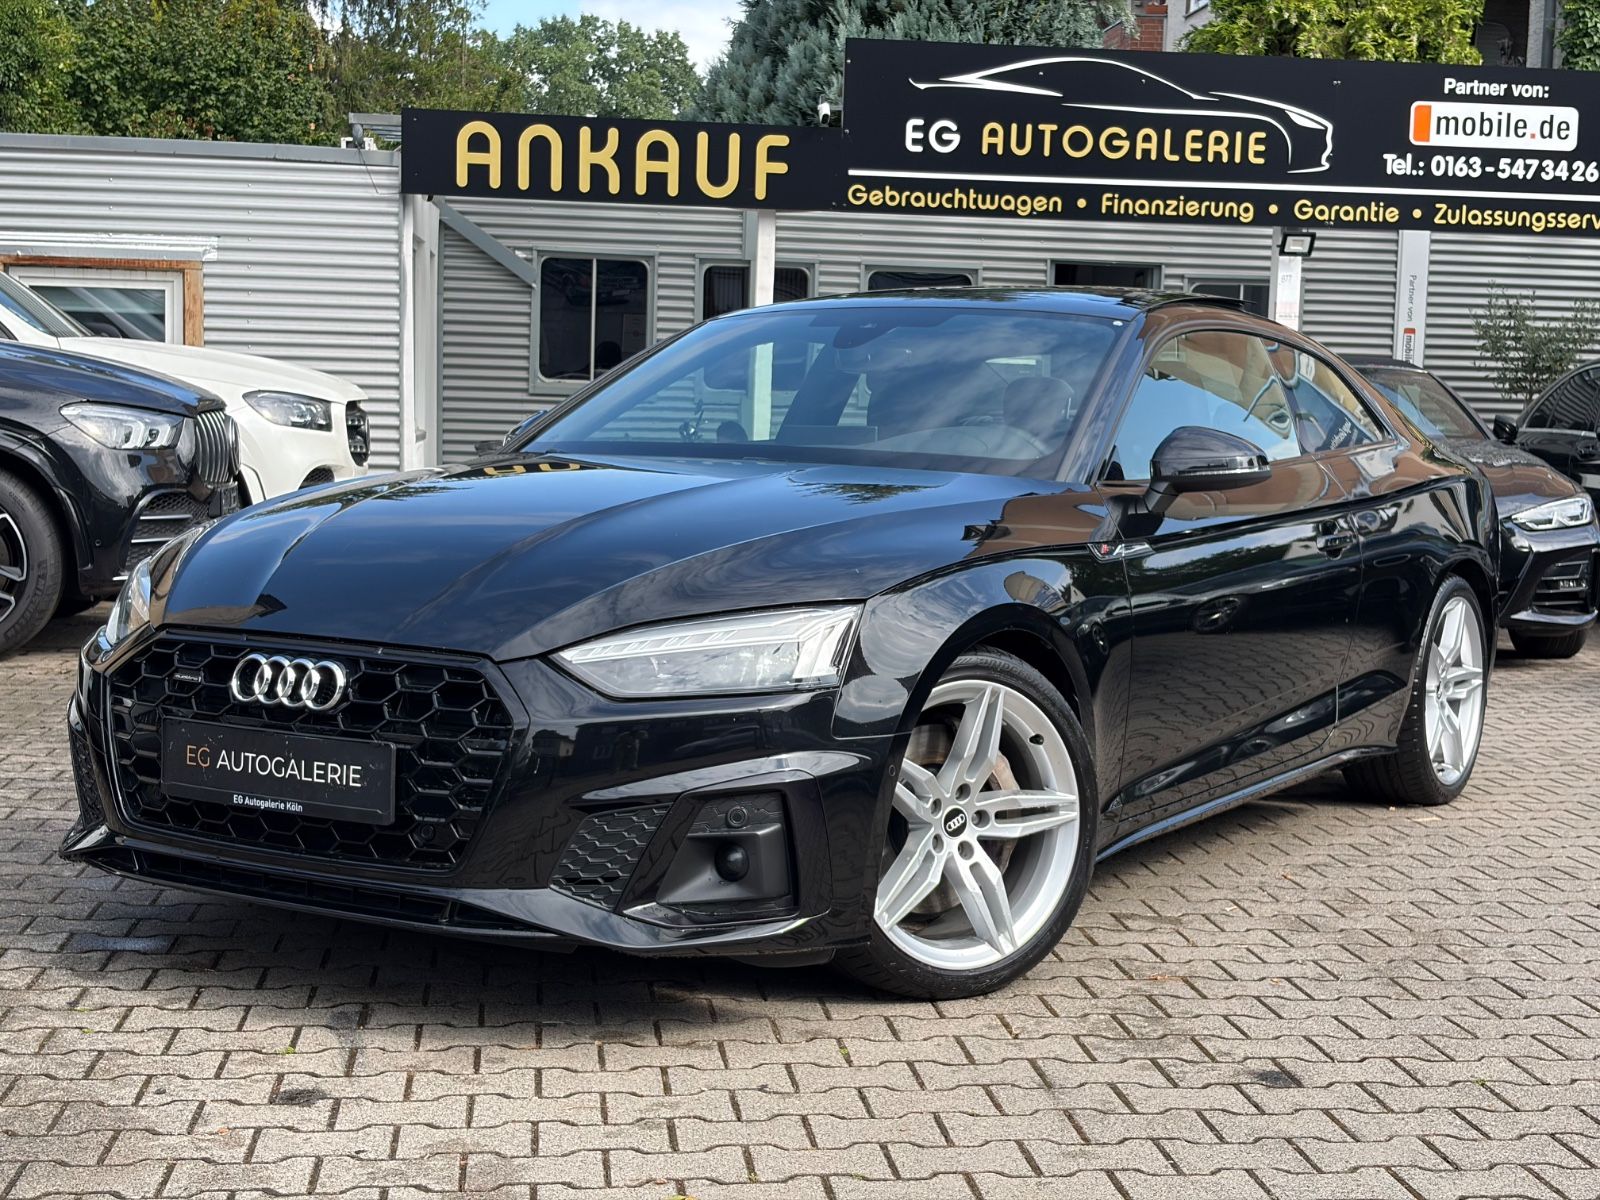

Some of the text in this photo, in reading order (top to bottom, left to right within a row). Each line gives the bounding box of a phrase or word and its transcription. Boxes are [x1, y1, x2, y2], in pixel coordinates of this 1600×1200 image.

[1444, 78, 1549, 98] Partner von:
[905, 119, 1267, 164] EG AUTOGALERIE
[1436, 112, 1571, 140] mobile.de
[456, 120, 790, 200] ANKAUF
[1383, 153, 1424, 176] Tel.:
[847, 184, 1600, 232] Gebrauchtwagen Finanzierung Garantie Zulassungsserv
[1408, 274, 1417, 305] Partner
[187, 745, 362, 787] EG AUTOGALERIE
[233, 794, 303, 812] EG Autogalerie Köln
